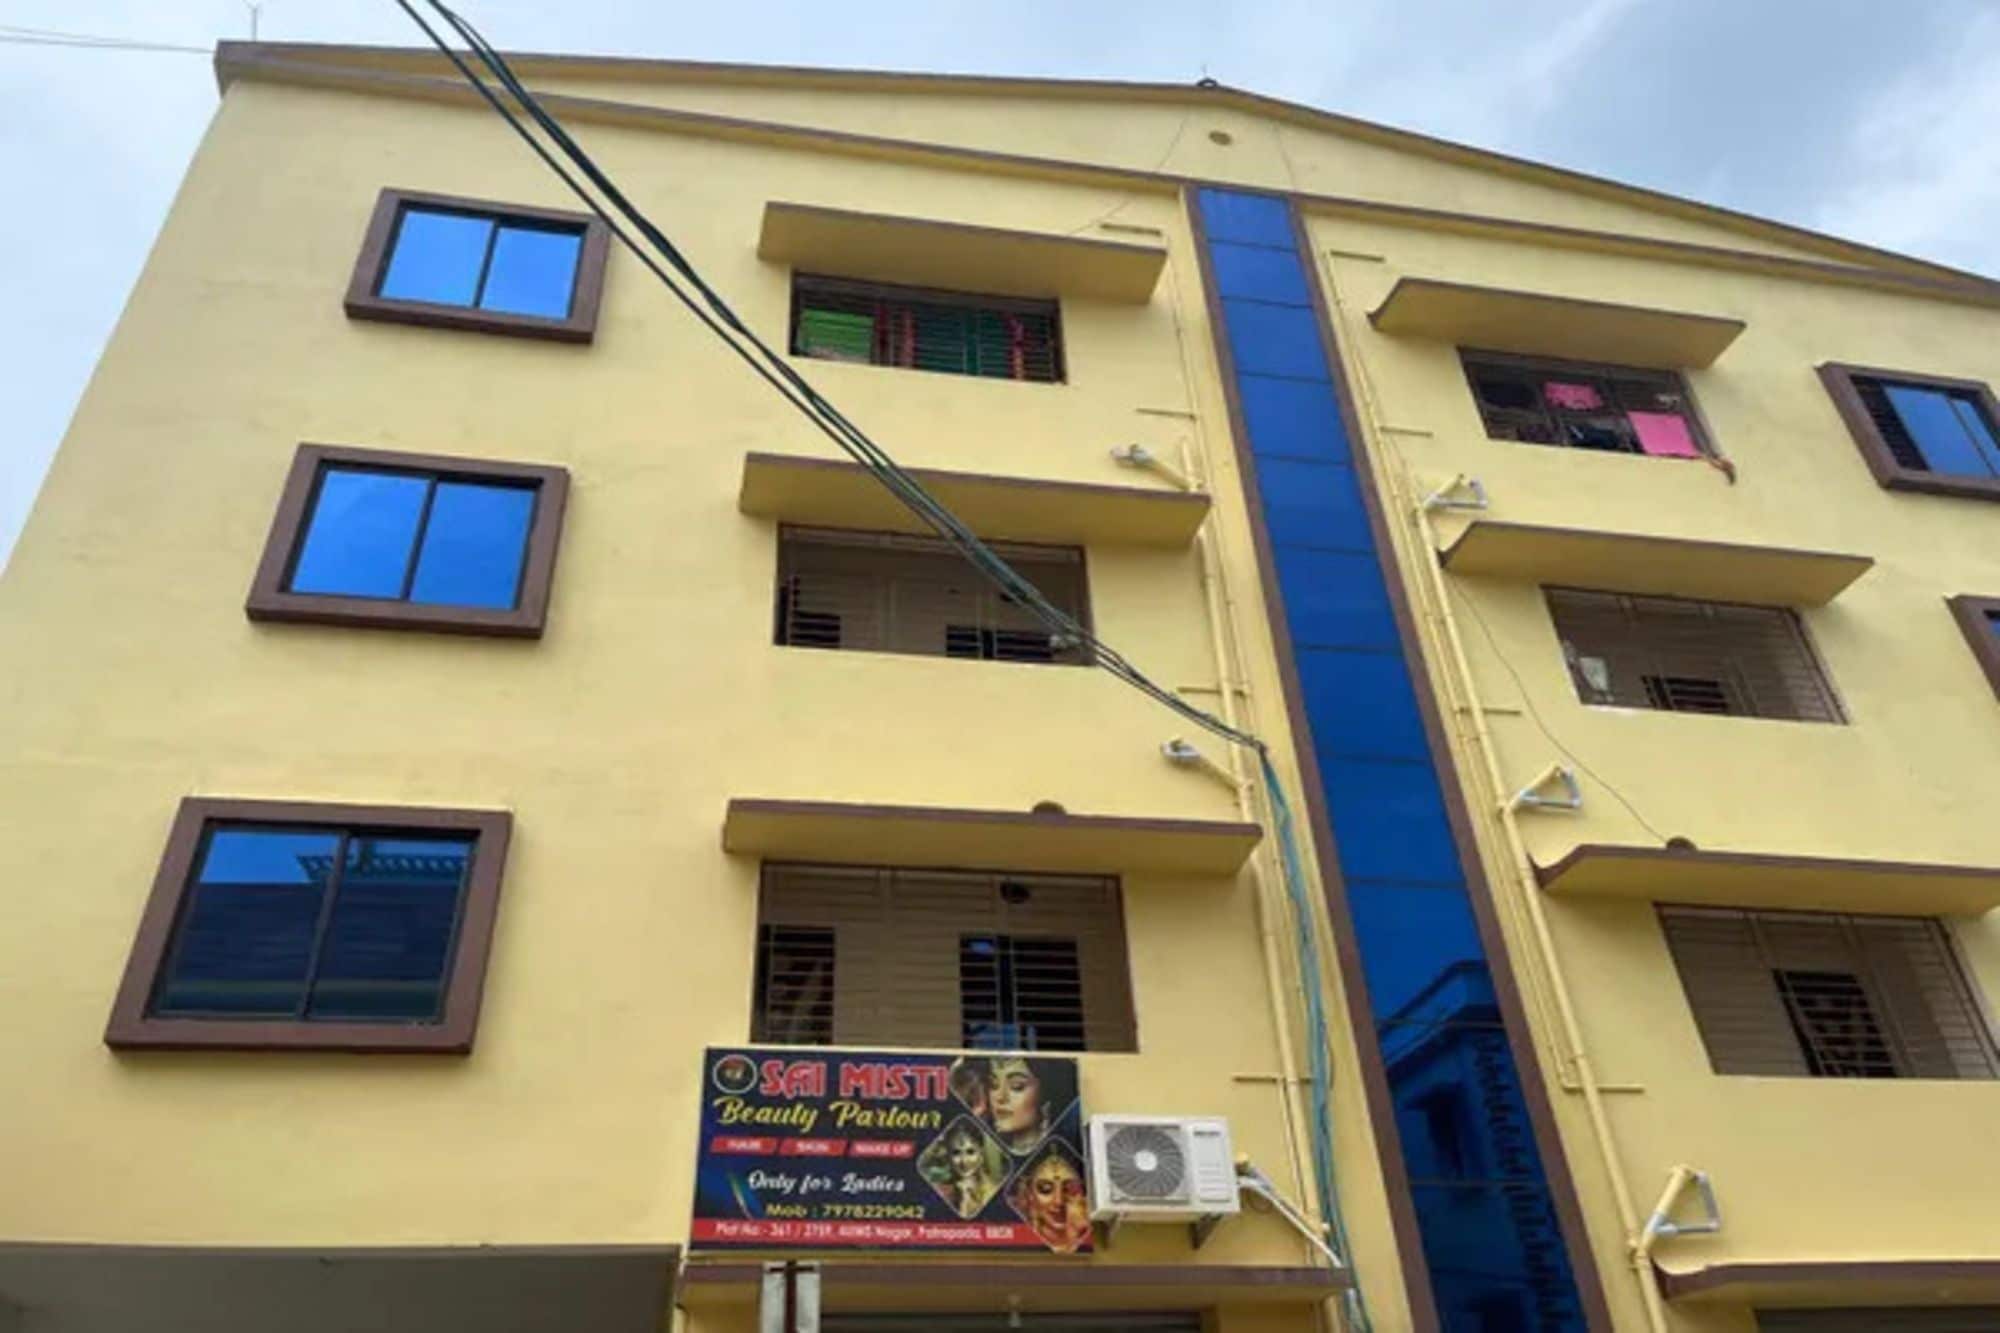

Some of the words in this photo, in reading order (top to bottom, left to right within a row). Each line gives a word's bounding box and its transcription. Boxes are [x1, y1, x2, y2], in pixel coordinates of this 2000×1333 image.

[760, 1060, 827, 1099] SAI
[839, 1062, 949, 1100] MISTI
[713, 1096, 818, 1133] Beauty
[829, 1101, 941, 1129] Parlour
[748, 1170, 797, 1193] Only
[799, 1173, 831, 1194] for
[840, 1172, 905, 1193] Ladies
